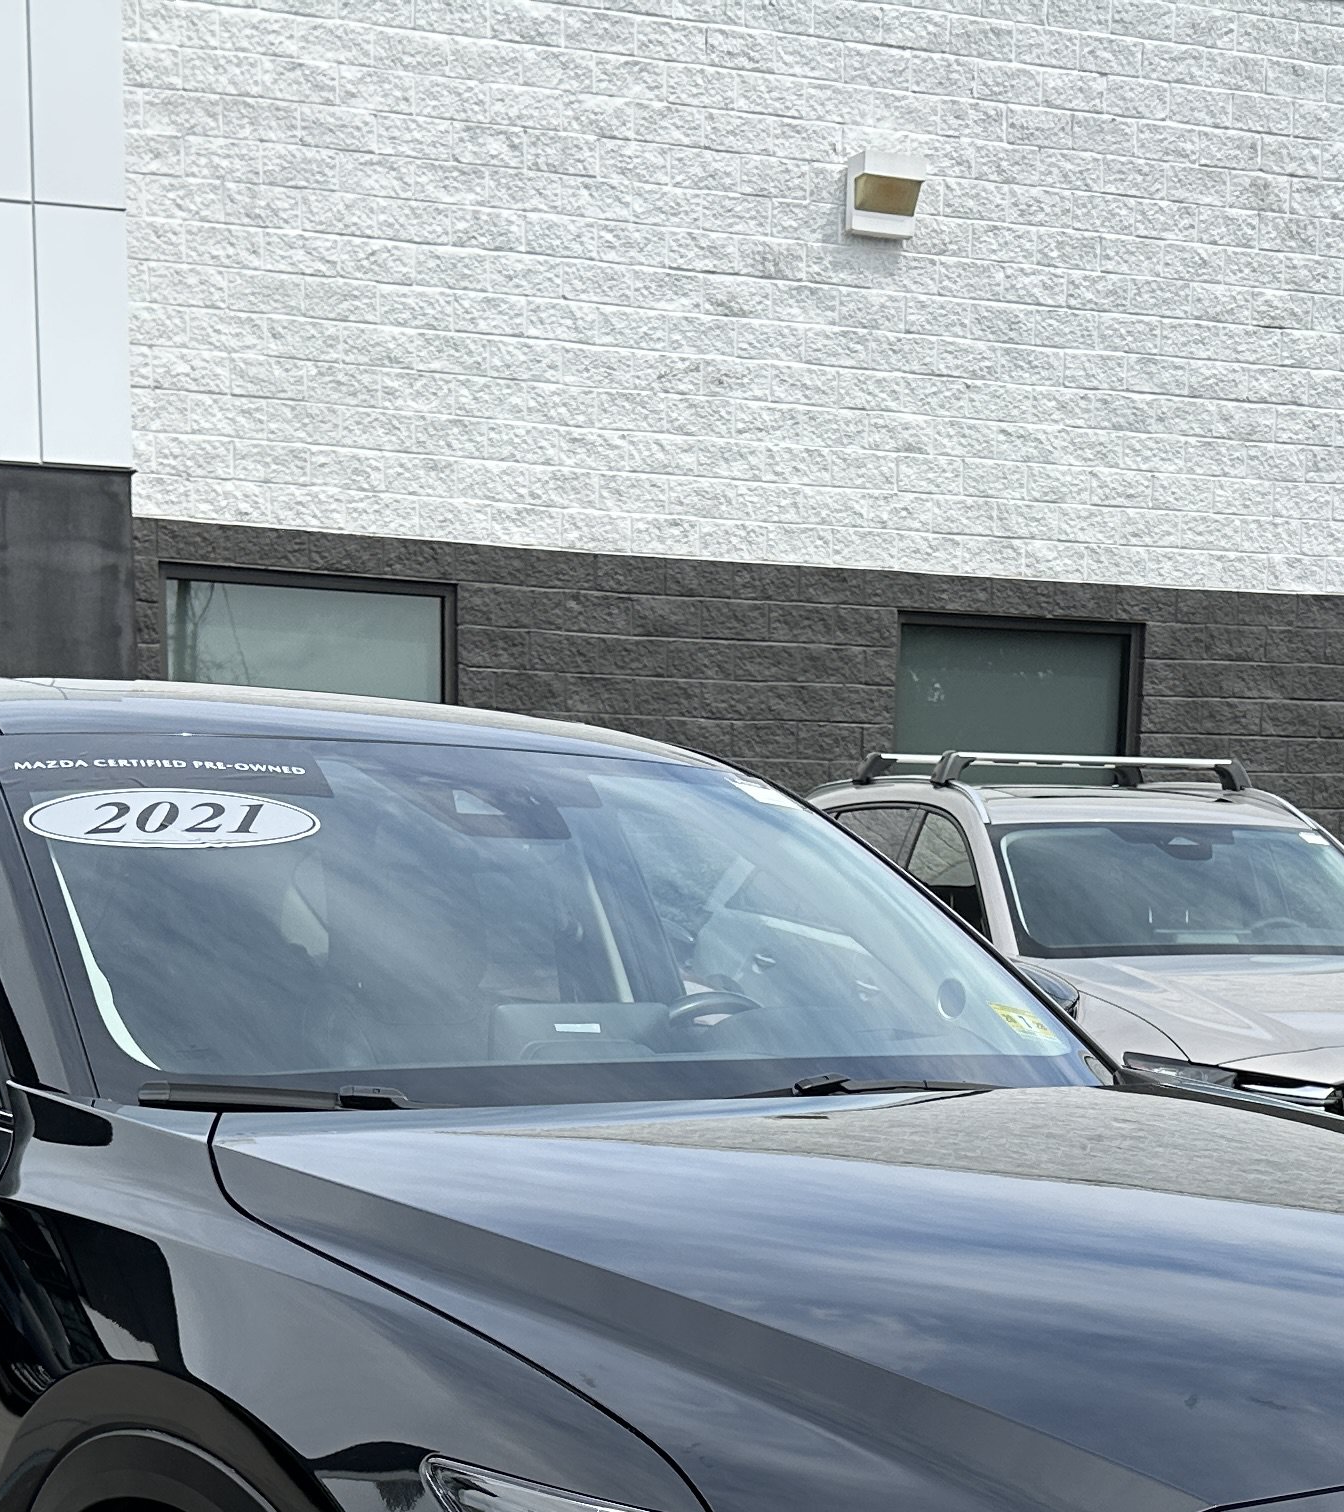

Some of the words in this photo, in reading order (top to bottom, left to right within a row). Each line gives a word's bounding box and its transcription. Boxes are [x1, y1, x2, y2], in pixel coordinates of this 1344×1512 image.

[14, 759, 88, 771] MAZDA
[93, 758, 187, 769] CERTIFIED
[193, 760, 306, 776] PRE-OWNED
[83, 800, 265, 835] 2021
